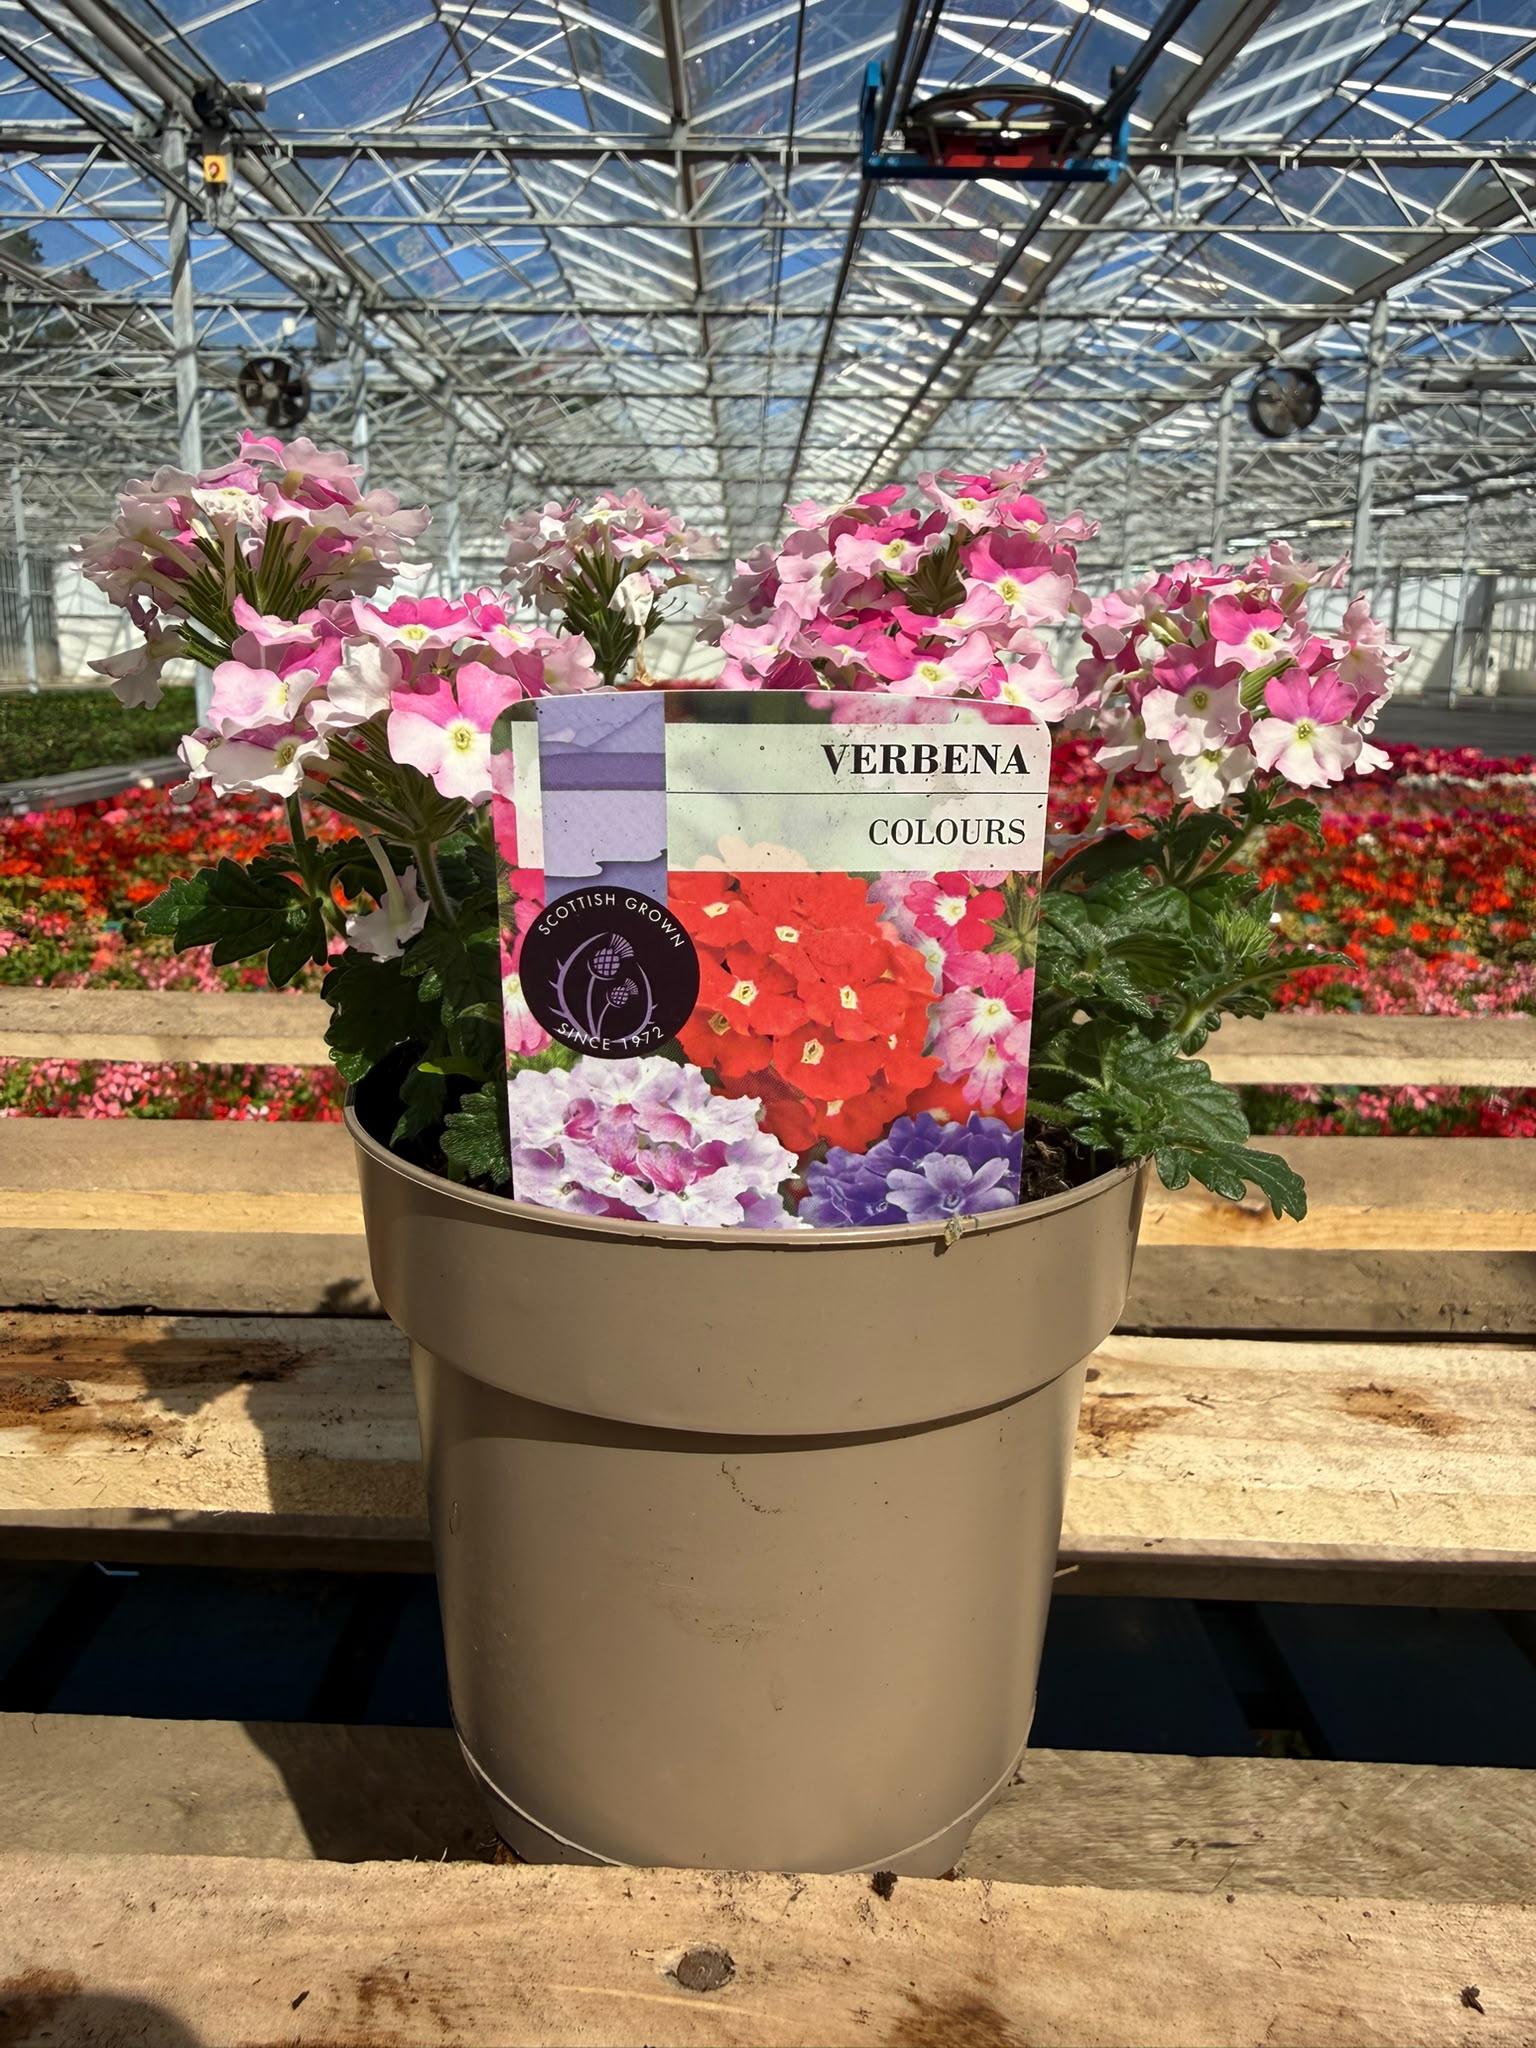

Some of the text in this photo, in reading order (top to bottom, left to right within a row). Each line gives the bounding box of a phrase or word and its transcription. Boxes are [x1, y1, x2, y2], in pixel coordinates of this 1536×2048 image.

[821, 744, 1031, 775] VERBENA
[868, 818, 1026, 846] COLOURS
[538, 893, 685, 948] SCOTTISH GROWN
[557, 1022, 665, 1051] SINCE 1972
